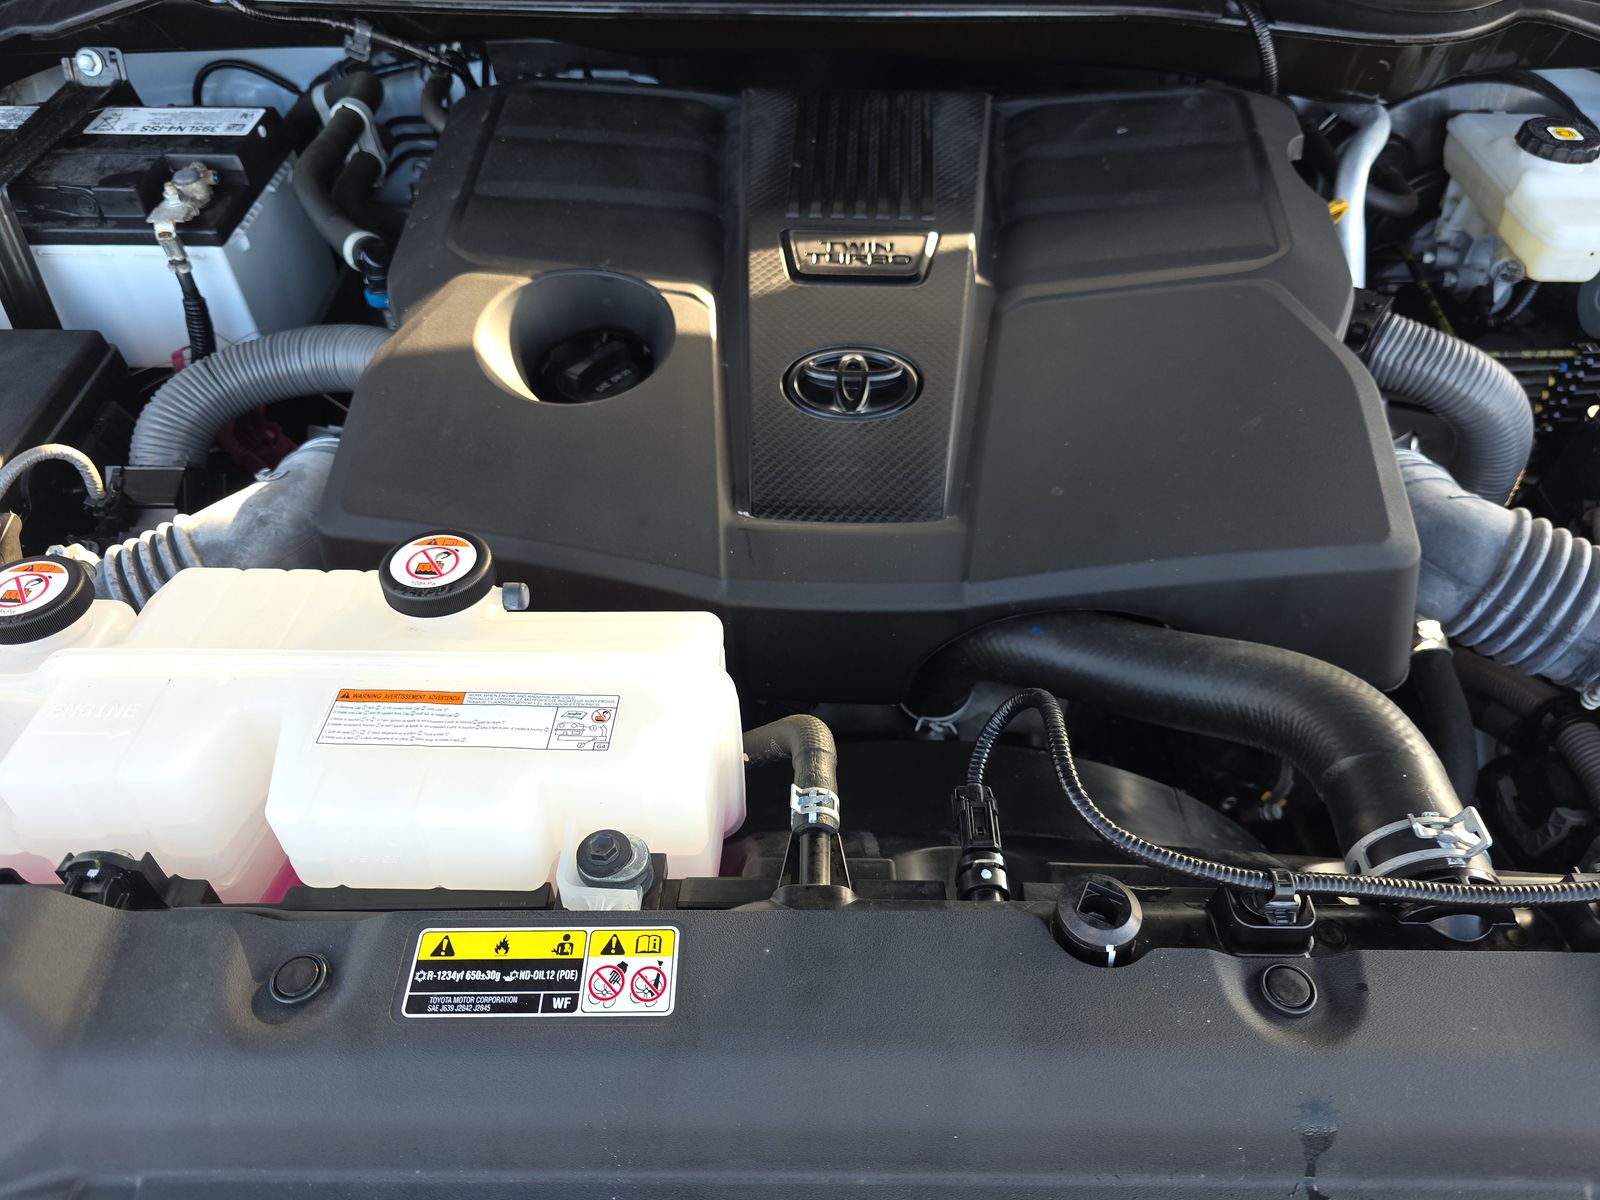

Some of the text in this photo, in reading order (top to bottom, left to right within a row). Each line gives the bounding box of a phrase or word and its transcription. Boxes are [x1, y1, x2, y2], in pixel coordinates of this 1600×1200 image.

[817, 239, 894, 254] TWIN
[803, 251, 912, 266] TURBO
[426, 969, 578, 983] R-1234yf 650±30g ND-OIL12 (POE)
[429, 995, 518, 1004] TOYOTA MOTOR CORPORATION
[552, 997, 571, 1009] WF
[427, 1004, 439, 1012] SAE
[439, 1004, 454, 1012] J639
